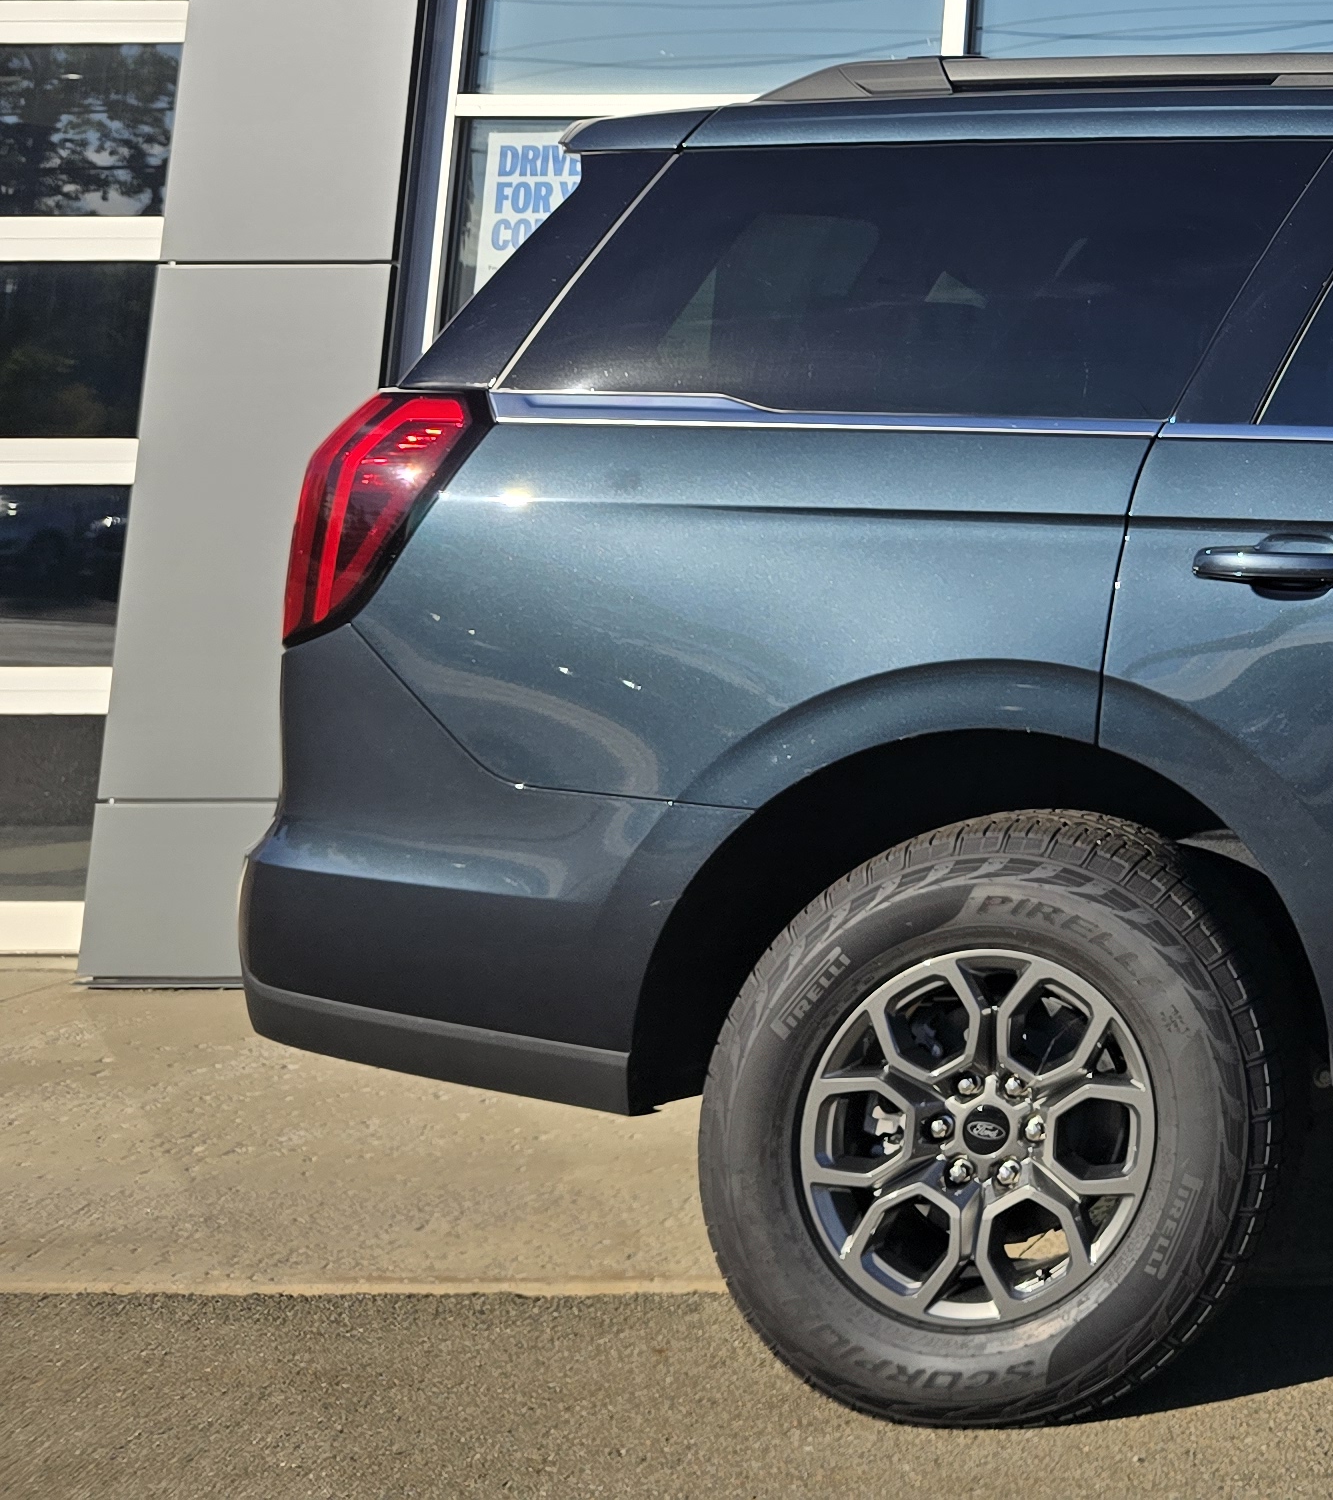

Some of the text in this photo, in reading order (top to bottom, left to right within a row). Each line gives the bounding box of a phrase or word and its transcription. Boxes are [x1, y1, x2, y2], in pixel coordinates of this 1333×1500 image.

[494, 181, 554, 214] FOR
[770, 945, 852, 1041] PIRELLI
[1141, 1177, 1203, 1283] PIRELLI
